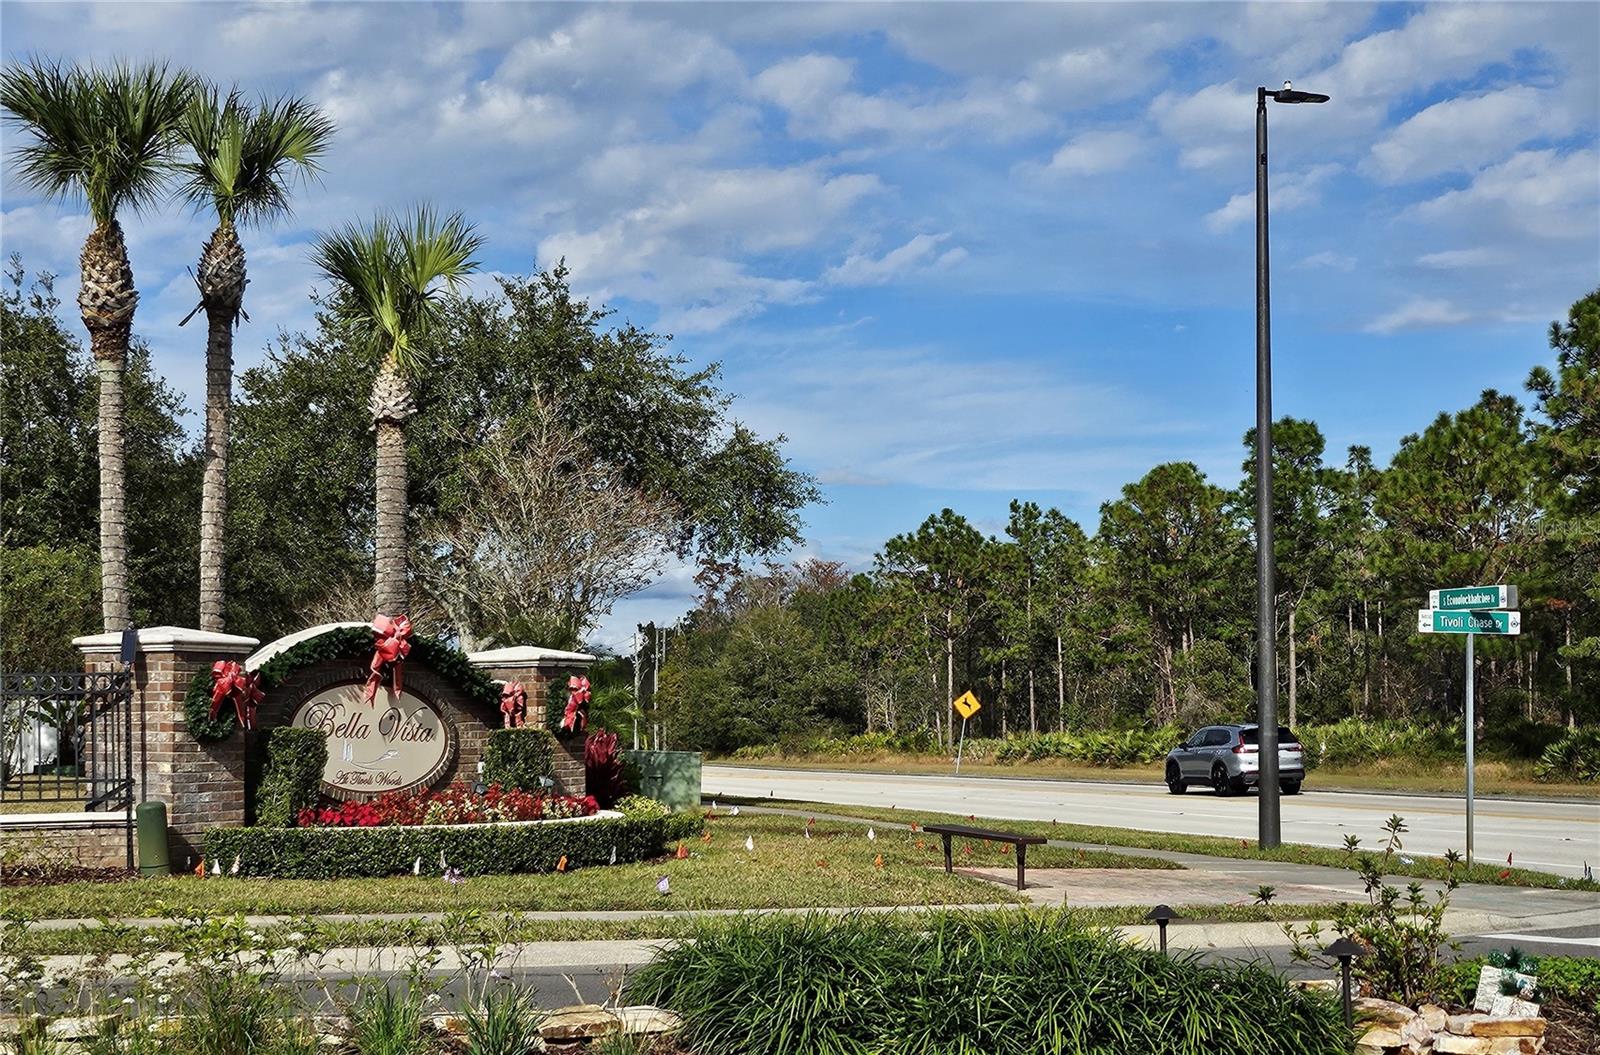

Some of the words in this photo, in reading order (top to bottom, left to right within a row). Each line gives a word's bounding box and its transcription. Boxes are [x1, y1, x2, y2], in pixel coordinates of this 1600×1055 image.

[1440, 615, 1464, 628] Tivoli
[1468, 616, 1493, 628] Chase
[1495, 620, 1503, 629] Dr
[303, 702, 371, 740] Bella
[378, 707, 434, 743] Vista
[333, 769, 350, 785] At
[350, 771, 374, 785] Tivoli
[375, 770, 403, 786] Woods
